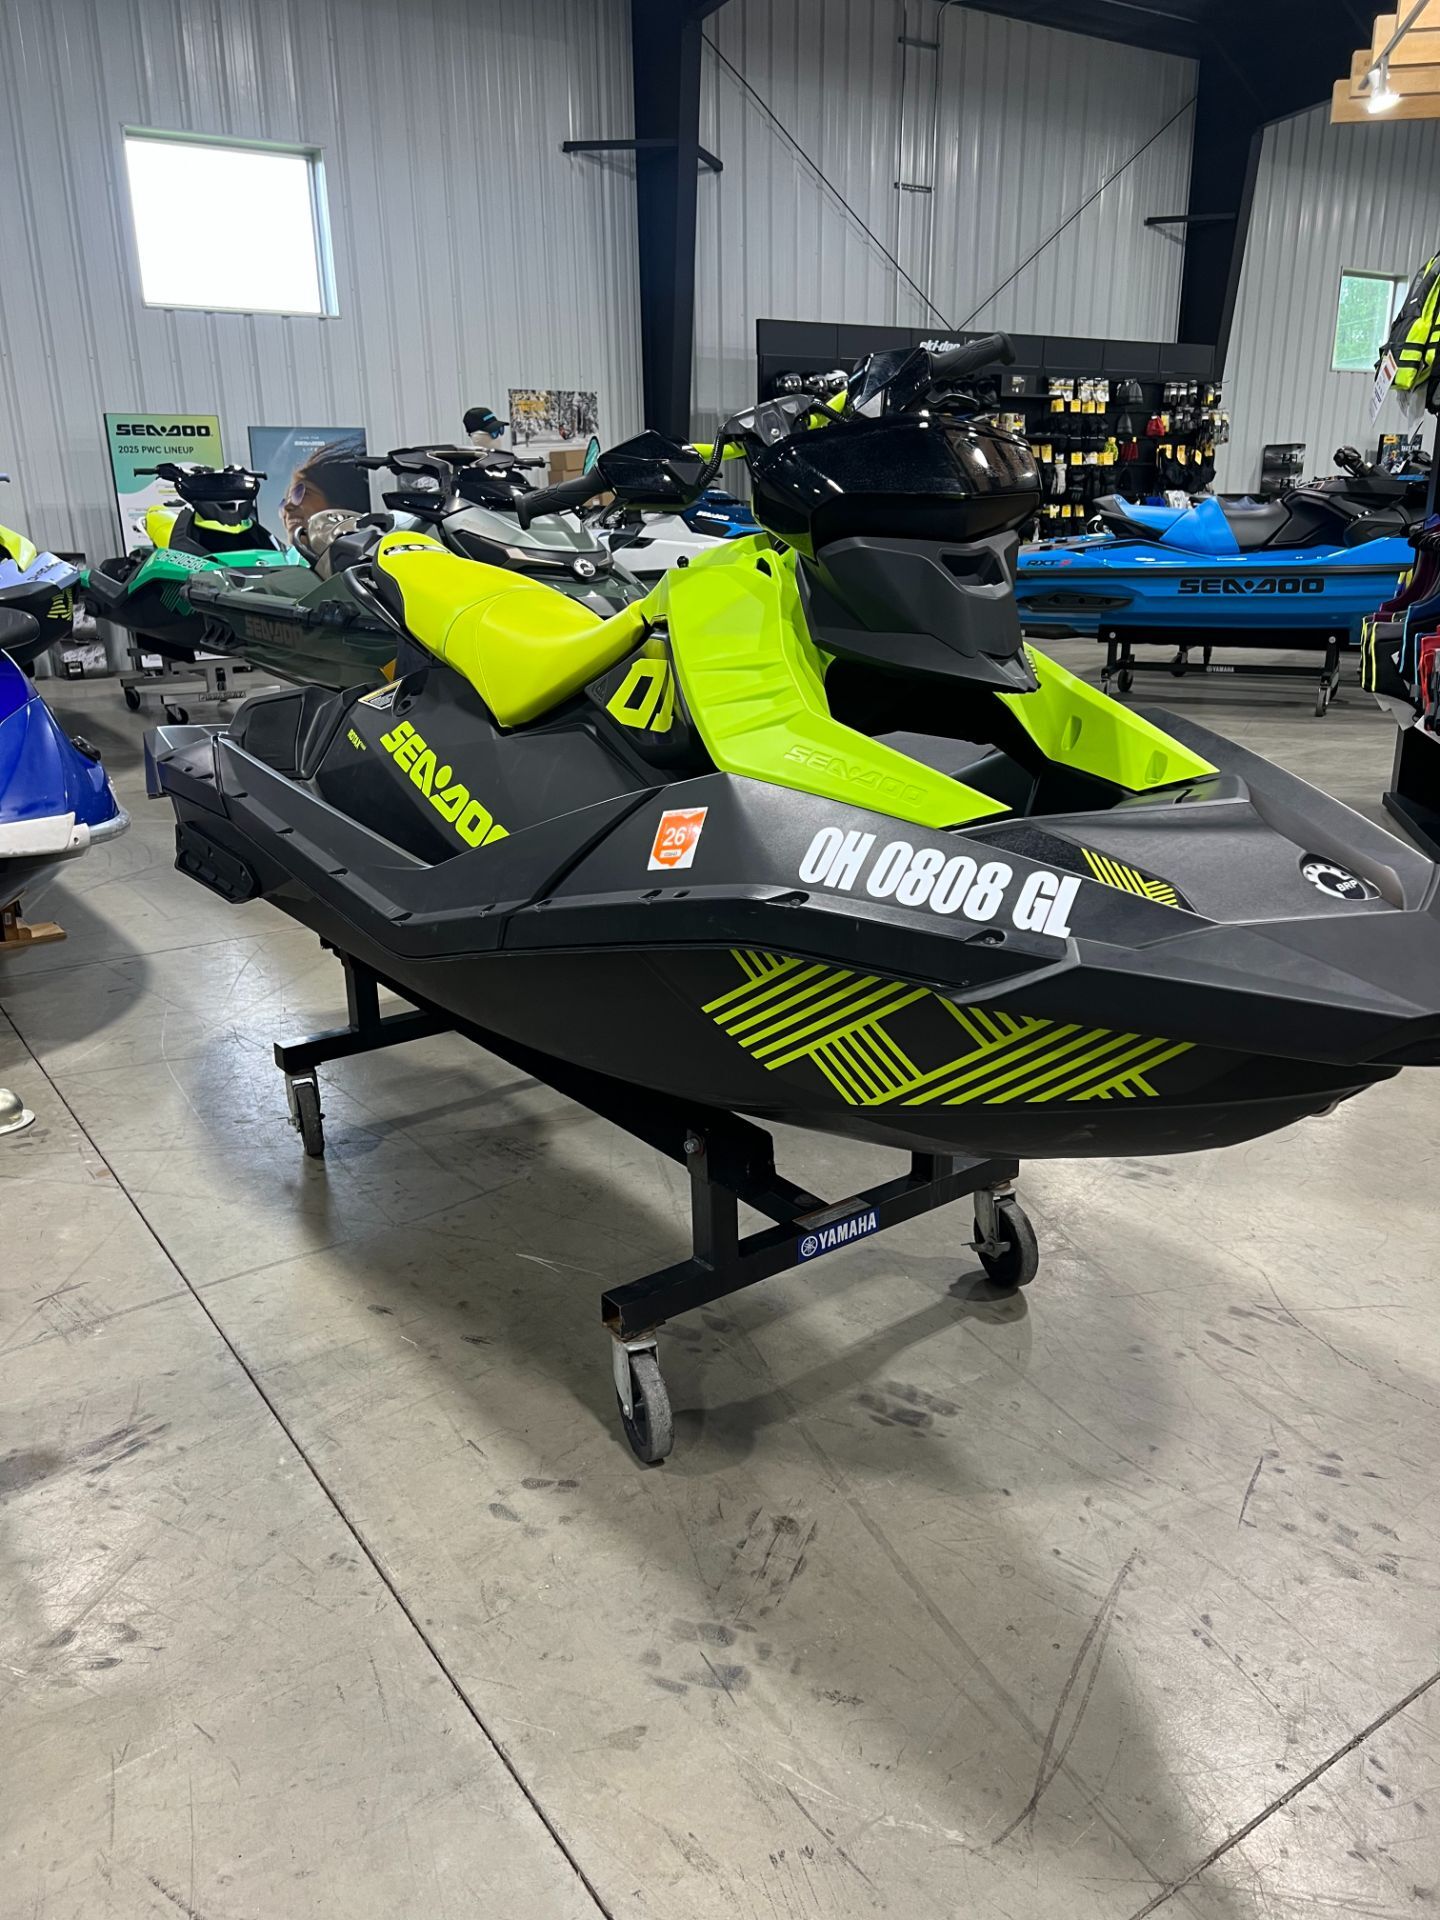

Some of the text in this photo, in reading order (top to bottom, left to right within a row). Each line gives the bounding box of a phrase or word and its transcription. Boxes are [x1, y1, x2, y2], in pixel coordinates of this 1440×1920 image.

[119, 446, 194, 454] 2025 PWC LINEUP
[1213, 665, 1235, 673] YAMAHA
[662, 826, 688, 847] 26
[799, 826, 1083, 938] OH 0808 GL
[1335, 880, 1358, 892] BRP
[819, 1211, 877, 1249] YAMAHA
